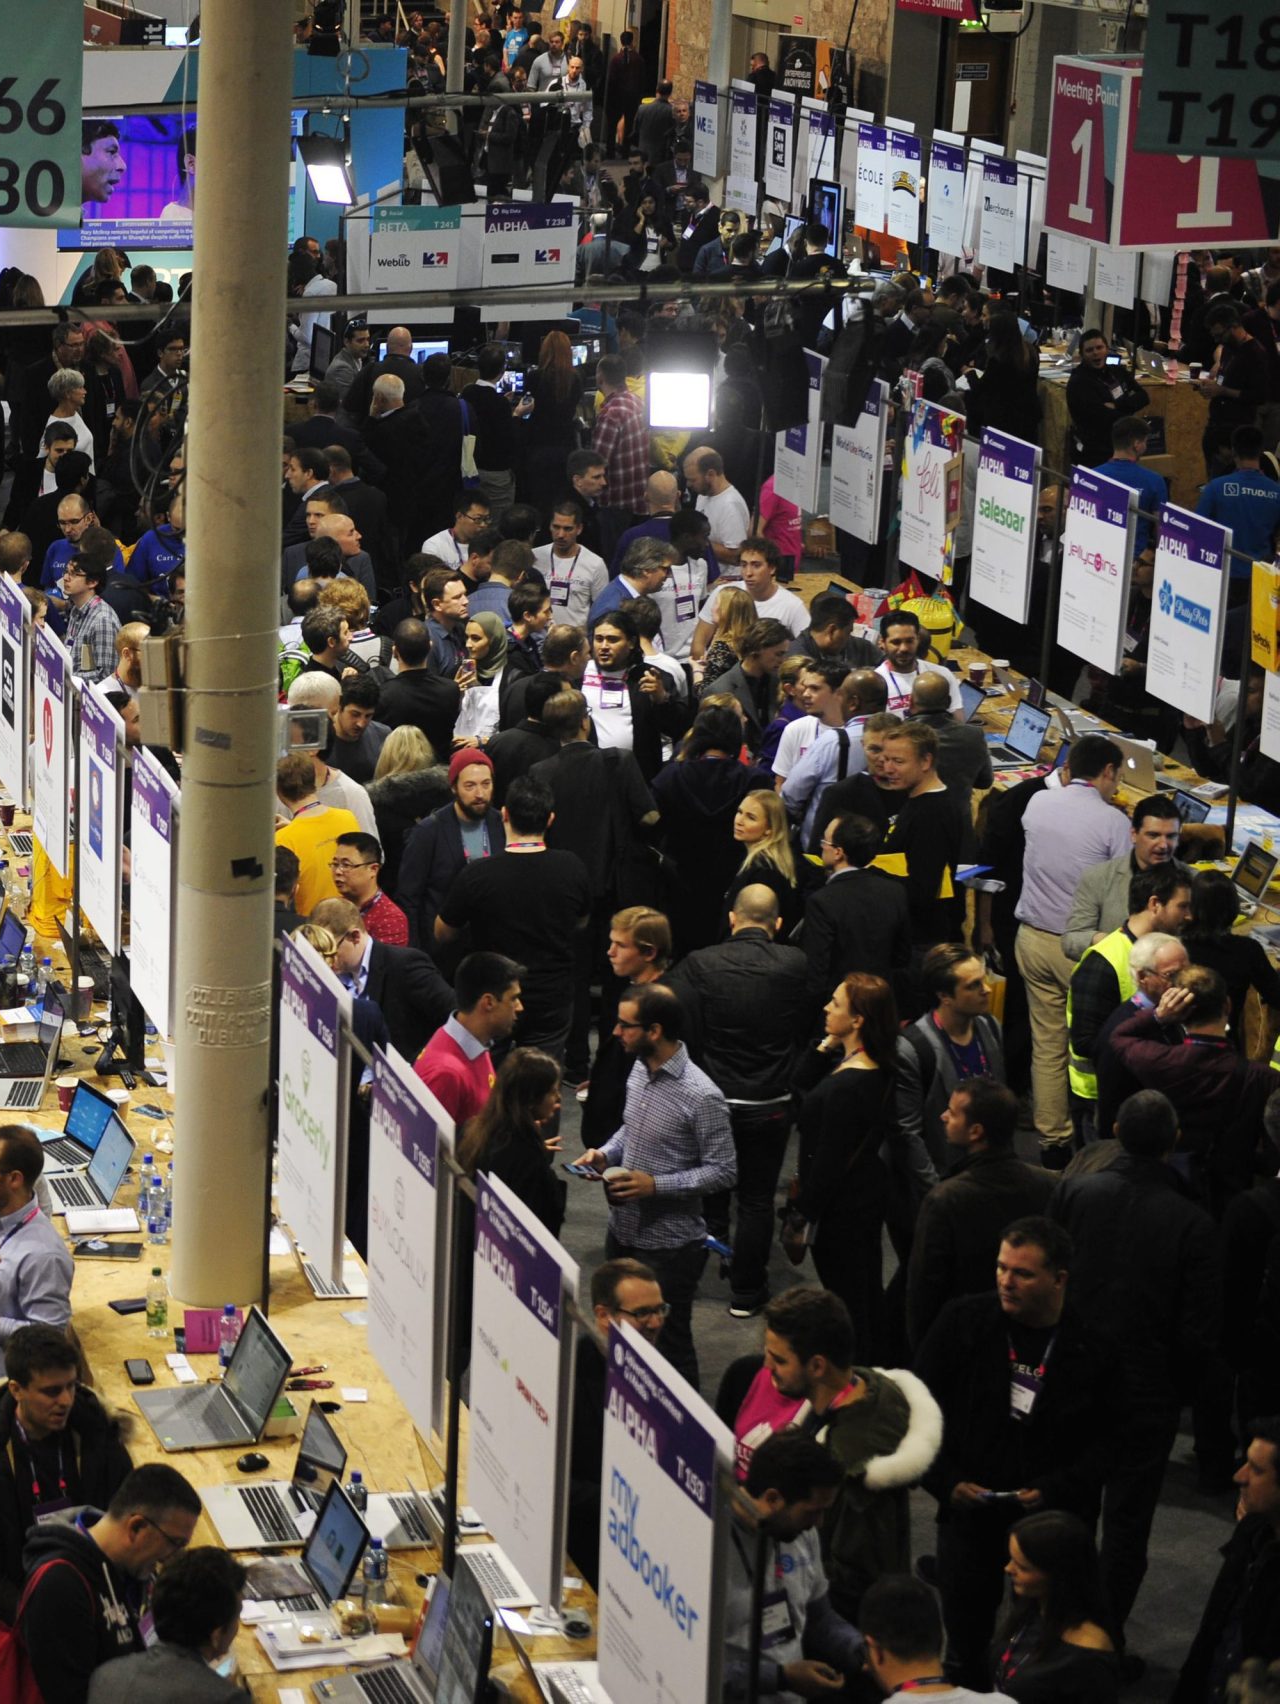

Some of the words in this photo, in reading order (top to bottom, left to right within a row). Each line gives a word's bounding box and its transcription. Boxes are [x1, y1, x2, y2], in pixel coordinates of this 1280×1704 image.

[1057, 76, 1093, 105] Meeting
[1095, 84, 1119, 107] Point
[858, 162, 884, 186] ÉCOLE
[1068, 119, 1093, 224] 1
[379, 221, 410, 233] BETA
[488, 220, 530, 233] ALPHA
[552, 218, 566, 227] 238
[377, 256, 411, 267] Weblib
[980, 455, 1005, 477] ALPHA
[1069, 495, 1097, 520] ALPHA
[1242, 486, 1279, 499] STUDLIST
[978, 496, 1025, 534] salesoar
[156, 554, 173, 562] Cart
[1158, 534, 1189, 560] ALPHA
[1206, 551, 1218, 564] 187
[282, 980, 309, 1030] ALPHA
[372, 1097, 403, 1151] ALPHA
[477, 1231, 517, 1292] ALPHA
[537, 1299, 554, 1327] 154
[657, 1391, 683, 1425] Content
[608, 1386, 659, 1465] ALPHA
[684, 1471, 705, 1505] 153
[611, 1465, 640, 1519] my
[607, 1506, 700, 1641] adbooker
